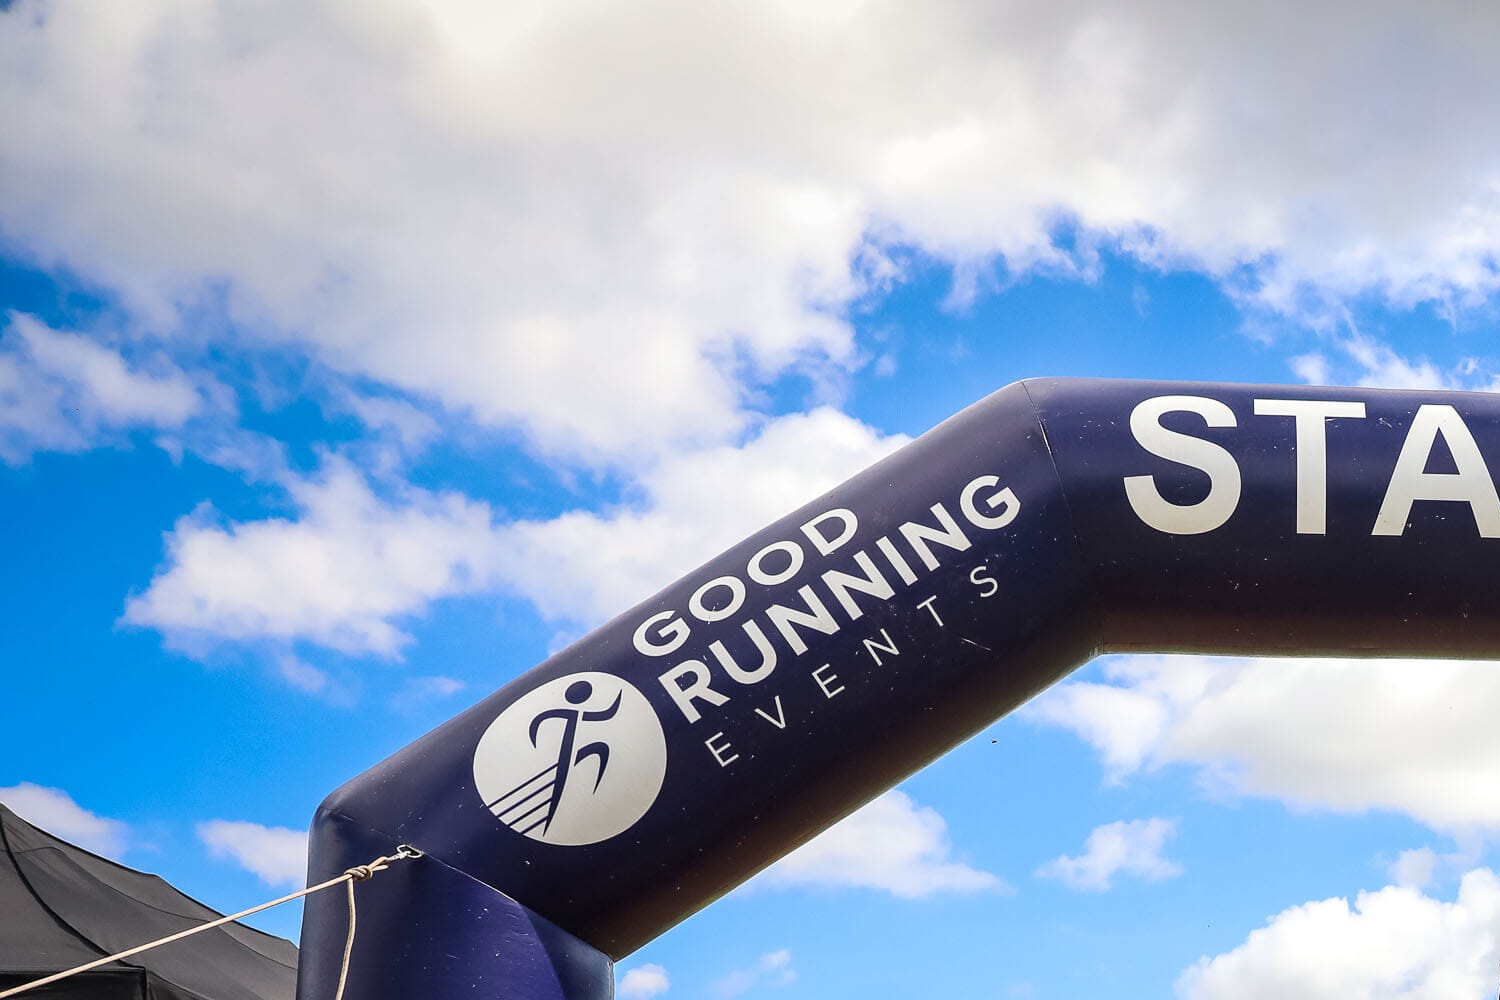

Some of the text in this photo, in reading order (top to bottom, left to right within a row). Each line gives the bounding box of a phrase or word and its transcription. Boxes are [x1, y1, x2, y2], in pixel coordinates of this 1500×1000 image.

[633, 508, 858, 657] GOOD
[657, 475, 1021, 724] RUNNING
[705, 565, 998, 767] EVENTS
